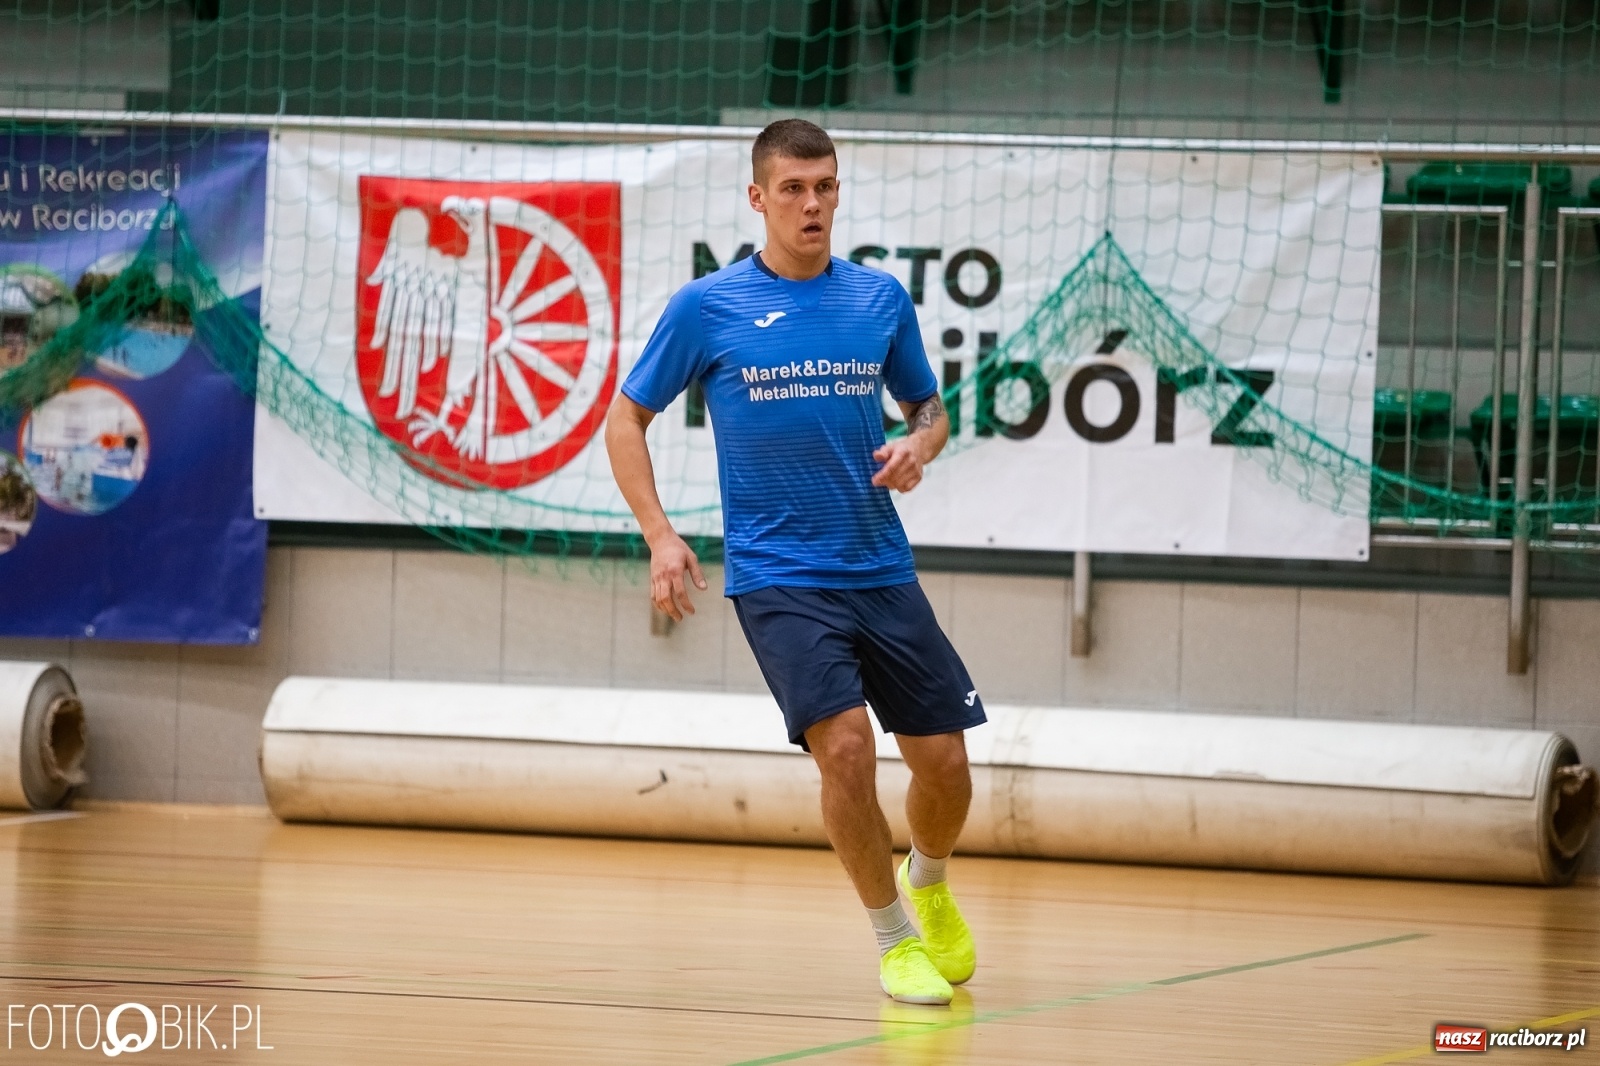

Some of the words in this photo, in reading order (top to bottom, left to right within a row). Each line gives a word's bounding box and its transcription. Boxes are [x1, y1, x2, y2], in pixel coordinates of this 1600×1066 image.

[20, 163, 29, 192] i
[38, 163, 181, 198] Rekreacji
[0, 209, 22, 230] w
[692, 242, 1003, 308] MTO
[741, 358, 882, 384] Marek&Dariusz
[686, 327, 1275, 448] ibórz
[749, 383, 830, 402] Metallbau
[834, 380, 875, 397] GmbH
